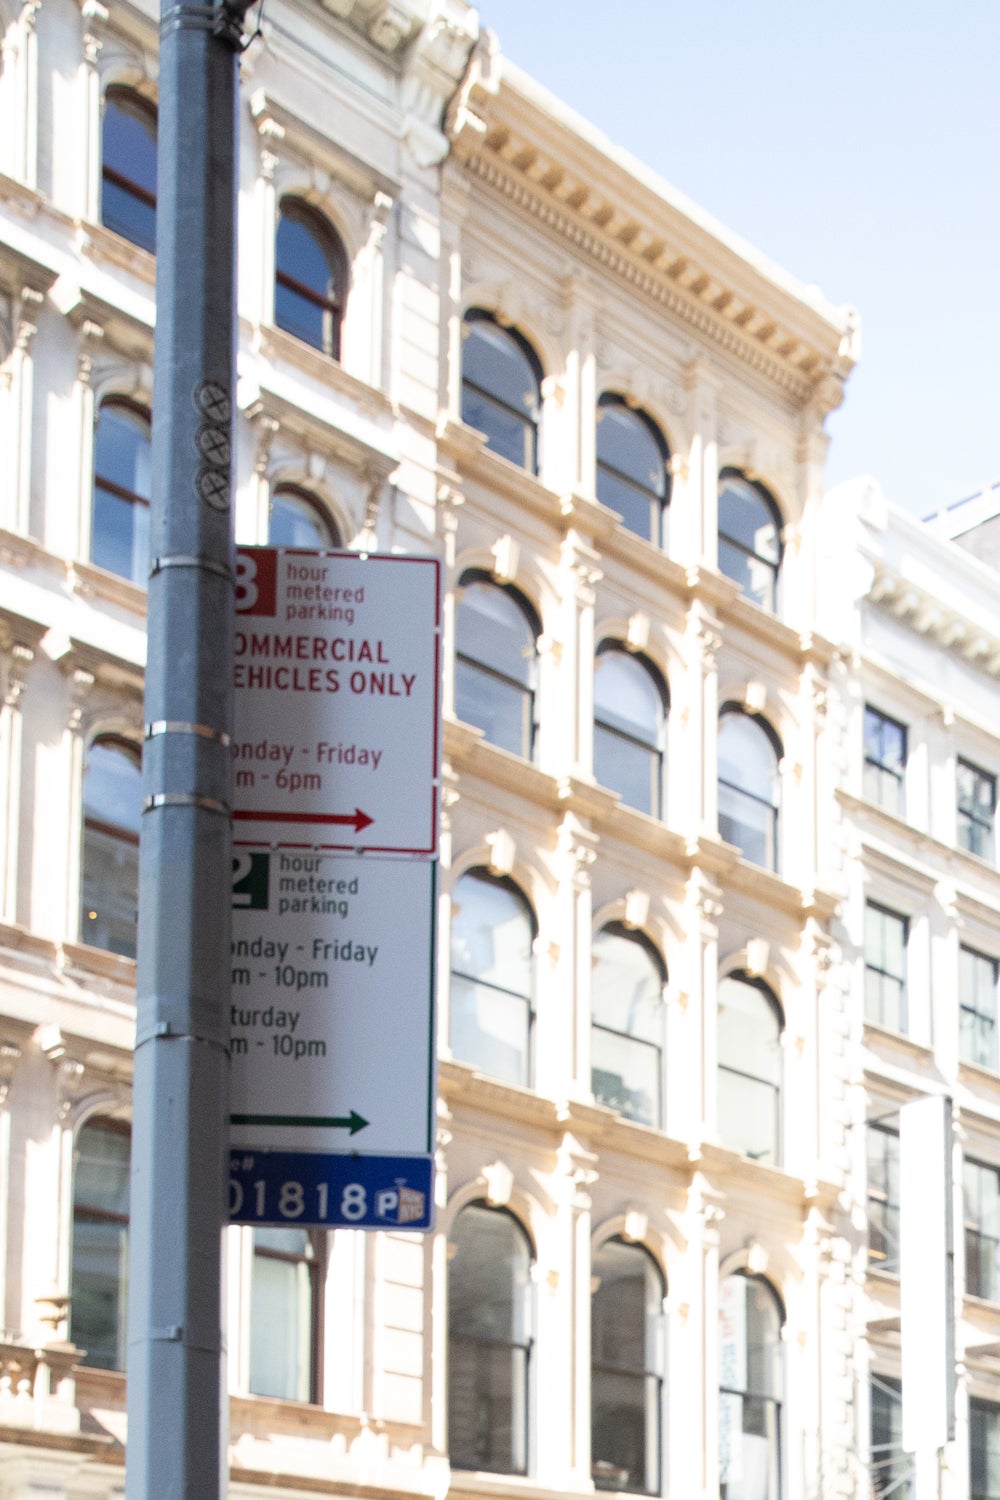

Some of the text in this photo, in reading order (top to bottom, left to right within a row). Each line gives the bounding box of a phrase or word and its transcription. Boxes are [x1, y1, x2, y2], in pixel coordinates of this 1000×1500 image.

[286, 563, 329, 581] hour
[286, 584, 365, 604] metered
[285, 604, 355, 626] parking
[235, 632, 390, 664] OMMERCIAL
[233, 665, 416, 697] EHICLES ONLY
[231, 741, 295, 767] onday
[316, 741, 383, 771] Friday
[275, 768, 322, 792] 6pm
[279, 854, 322, 873] hour
[278, 876, 360, 896] metered
[278, 896, 349, 919] parking
[230, 936, 290, 963] nday
[312, 938, 379, 967] Friday
[275, 965, 329, 992] 10pm
[230, 1004, 300, 1033] turday
[273, 1033, 327, 1060] 10pm
[230, 1179, 368, 1222] 01818
